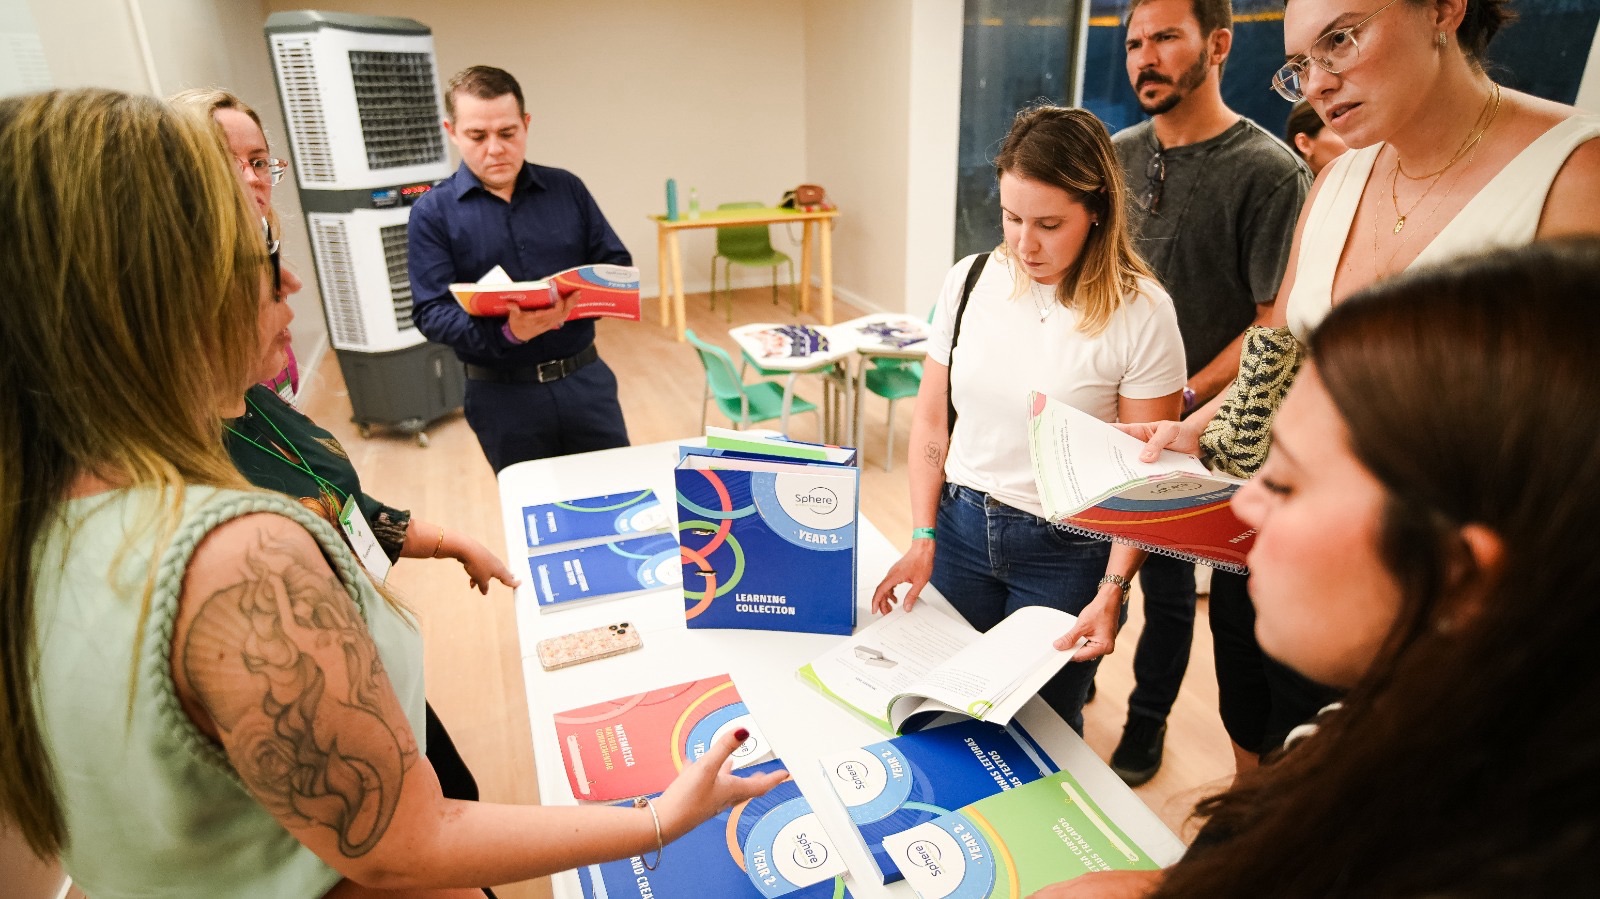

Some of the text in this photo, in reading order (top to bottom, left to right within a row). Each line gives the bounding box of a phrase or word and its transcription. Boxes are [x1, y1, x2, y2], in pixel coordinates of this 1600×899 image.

[795, 493, 833, 505] Sphere
[799, 529, 839, 545] YEAR 2
[735, 593, 787, 605] LEARNING
[735, 603, 796, 615] COLLECTION
[614, 723, 636, 767] MATEMÁTICA
[693, 742, 705, 760] YEA
[845, 764, 866, 790] Sphere
[881, 750, 904, 779] YEAR 2
[964, 737, 1012, 791] NHAS LEITURAS
[987, 750, 1014, 777] TEXTOS
[796, 832, 818, 864] Sphere
[953, 823, 984, 861] YEAR 2
[1052, 824, 1101, 873] ETRA CURSIVA
[1057, 817, 1093, 853] TRAÇADOS
[629, 855, 655, 899] AND CREA
[753, 849, 777, 886] YEAR 2
[915, 845, 942, 877] Sphere
